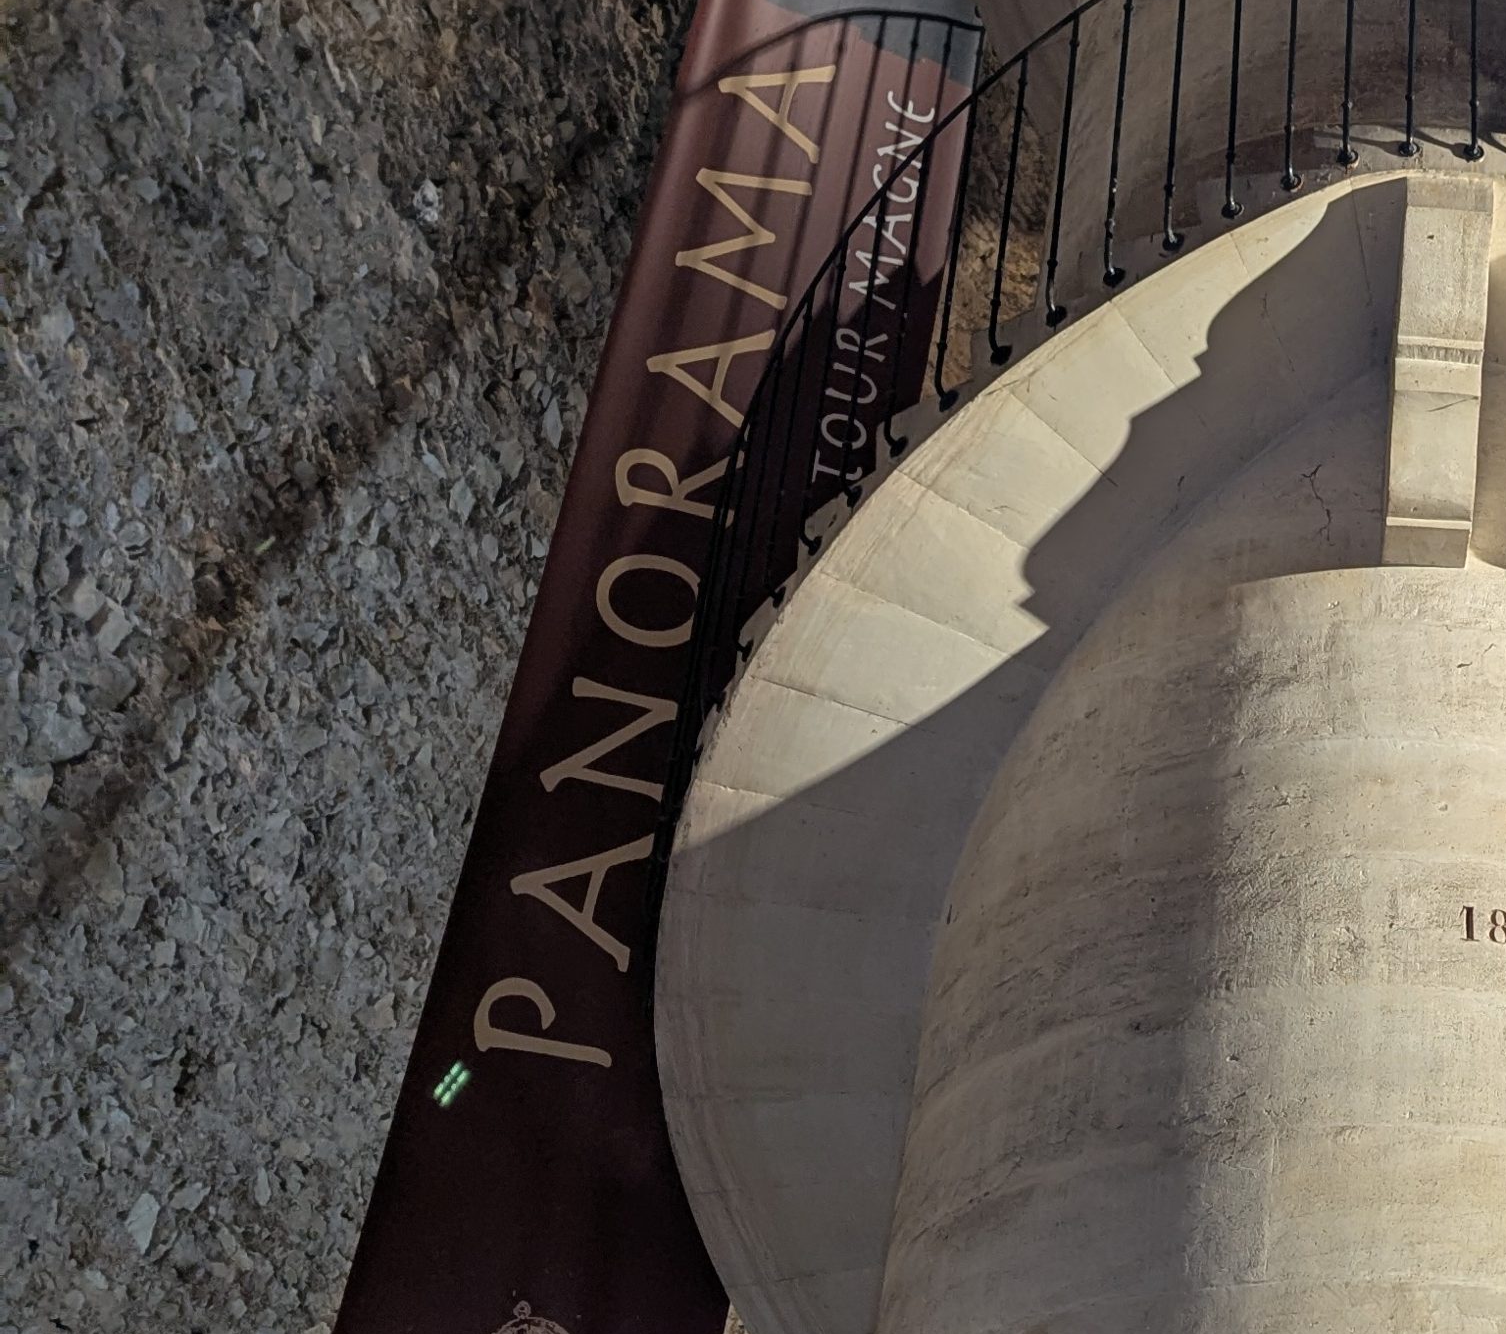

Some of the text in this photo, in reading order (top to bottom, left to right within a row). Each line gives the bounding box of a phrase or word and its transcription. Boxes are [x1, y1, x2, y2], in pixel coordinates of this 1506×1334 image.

[473, 65, 837, 1068] PANORAMA
[811, 90, 937, 484] TOUR MAGNE
